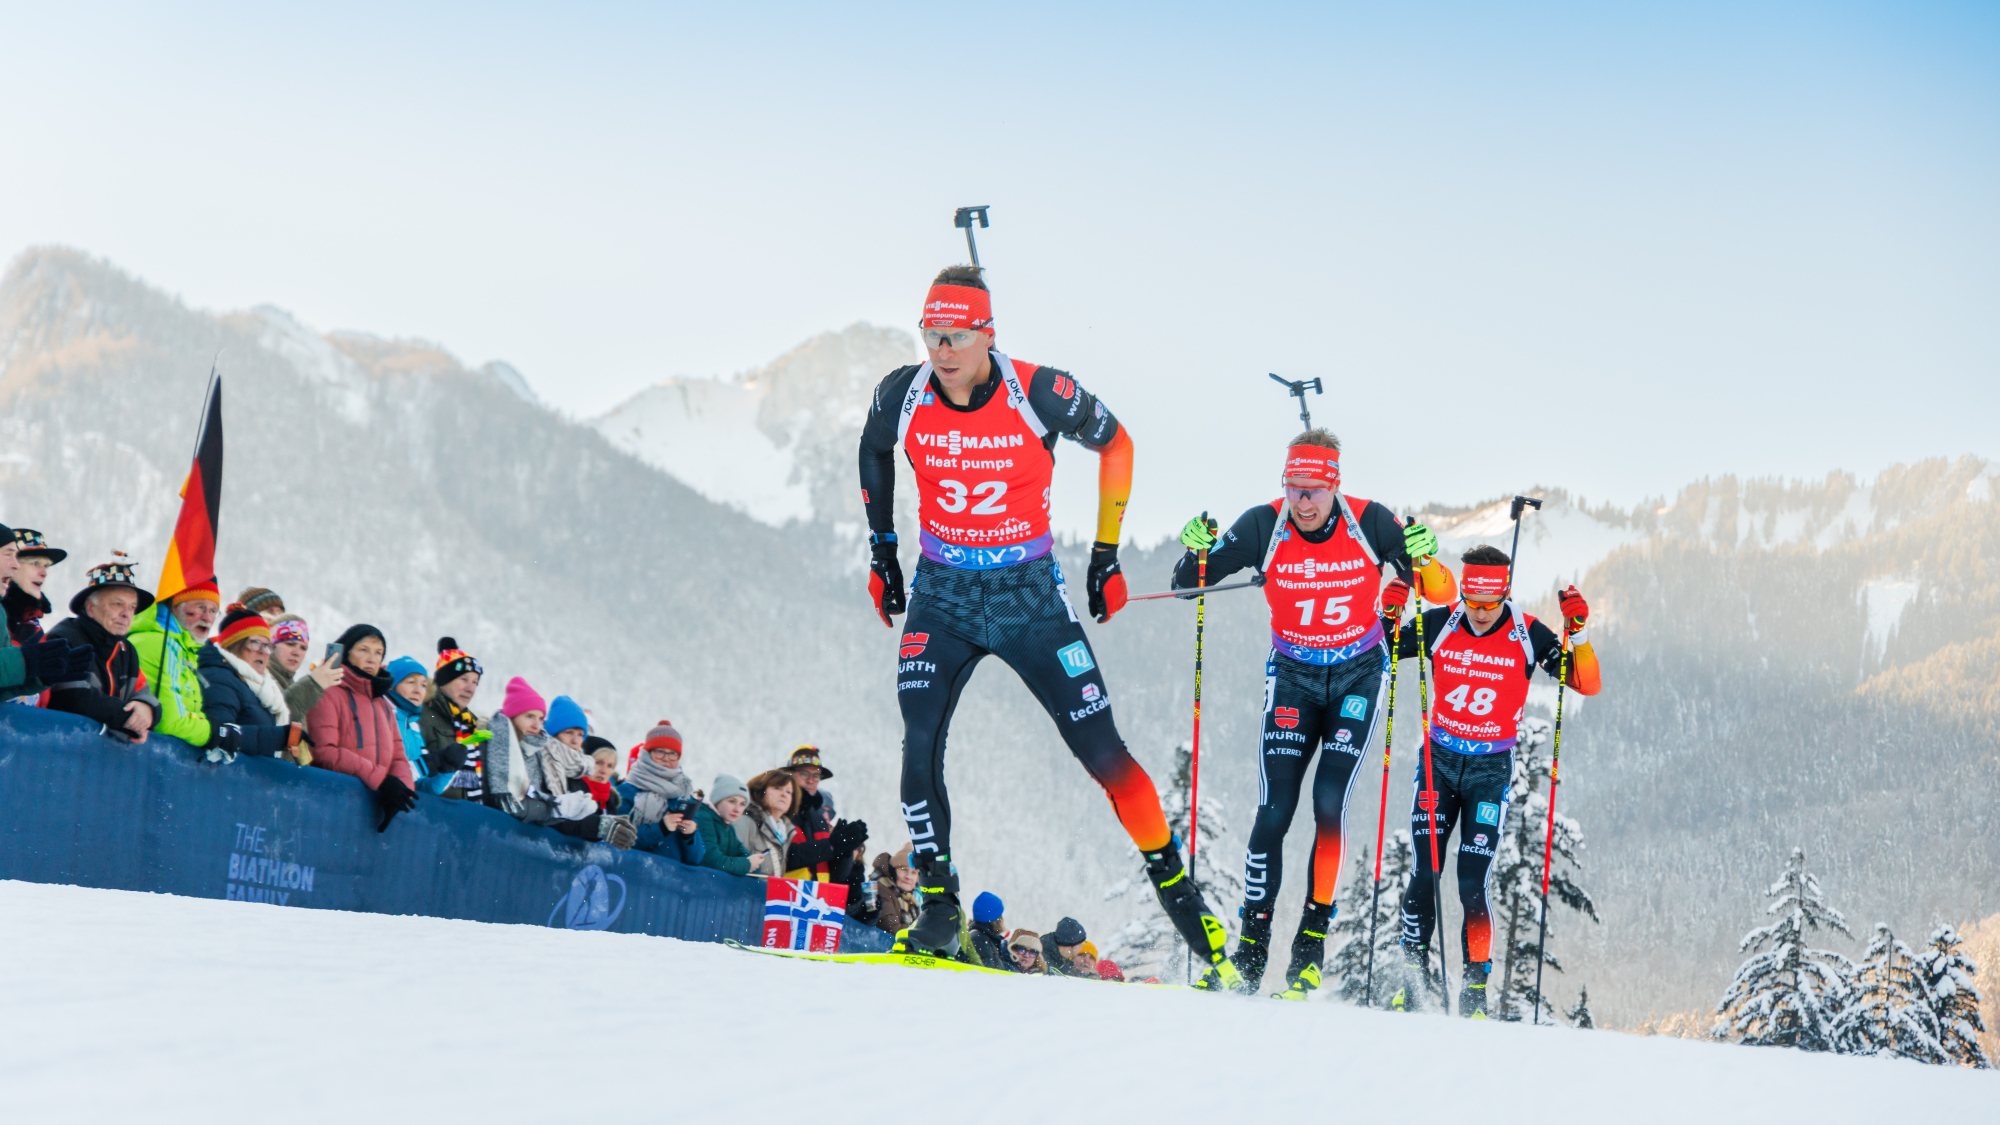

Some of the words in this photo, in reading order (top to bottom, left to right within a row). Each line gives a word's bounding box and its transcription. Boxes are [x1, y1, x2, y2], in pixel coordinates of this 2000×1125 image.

[1006, 378, 1025, 404] JOKA
[904, 389, 919, 416] JOKA
[915, 430, 1024, 455] VIESSMANN
[925, 455, 958, 469] Heat
[961, 457, 1014, 472] pumps
[936, 479, 1008, 516] 32
[998, 530, 1032, 543] ALPEN
[1276, 558, 1365, 579] VIESSMANN
[1276, 576, 1365, 591] Wärmepumpen
[1294, 594, 1353, 626] 15
[1447, 609, 1461, 627] JOKA
[1516, 623, 1528, 641] JOKA
[898, 660, 936, 674] ÜRTH
[1062, 646, 1091, 669] TQ
[1439, 648, 1515, 668] VIESSMANN
[1443, 663, 1466, 675] Heat
[1468, 669, 1504, 681] pumps
[1559, 657, 1568, 687] LEKI
[1069, 694, 1111, 722] tectak
[1345, 698, 1363, 718] TQ
[1444, 683, 1497, 716] 48
[1264, 731, 1306, 744] WÜRTH
[1275, 747, 1302, 757] TERREX
[1412, 813, 1446, 823] WÜTH
[1481, 804, 1497, 823] TQ
[235, 822, 267, 854] THE
[1461, 843, 1495, 858] tectake
[227, 852, 316, 893] BIATHLON
[1244, 848, 1267, 901] GER
[1401, 907, 1421, 943] ER
[765, 927, 778, 949] NO
[823, 928, 838, 954] BIAT
[903, 955, 936, 968] FISCHER
